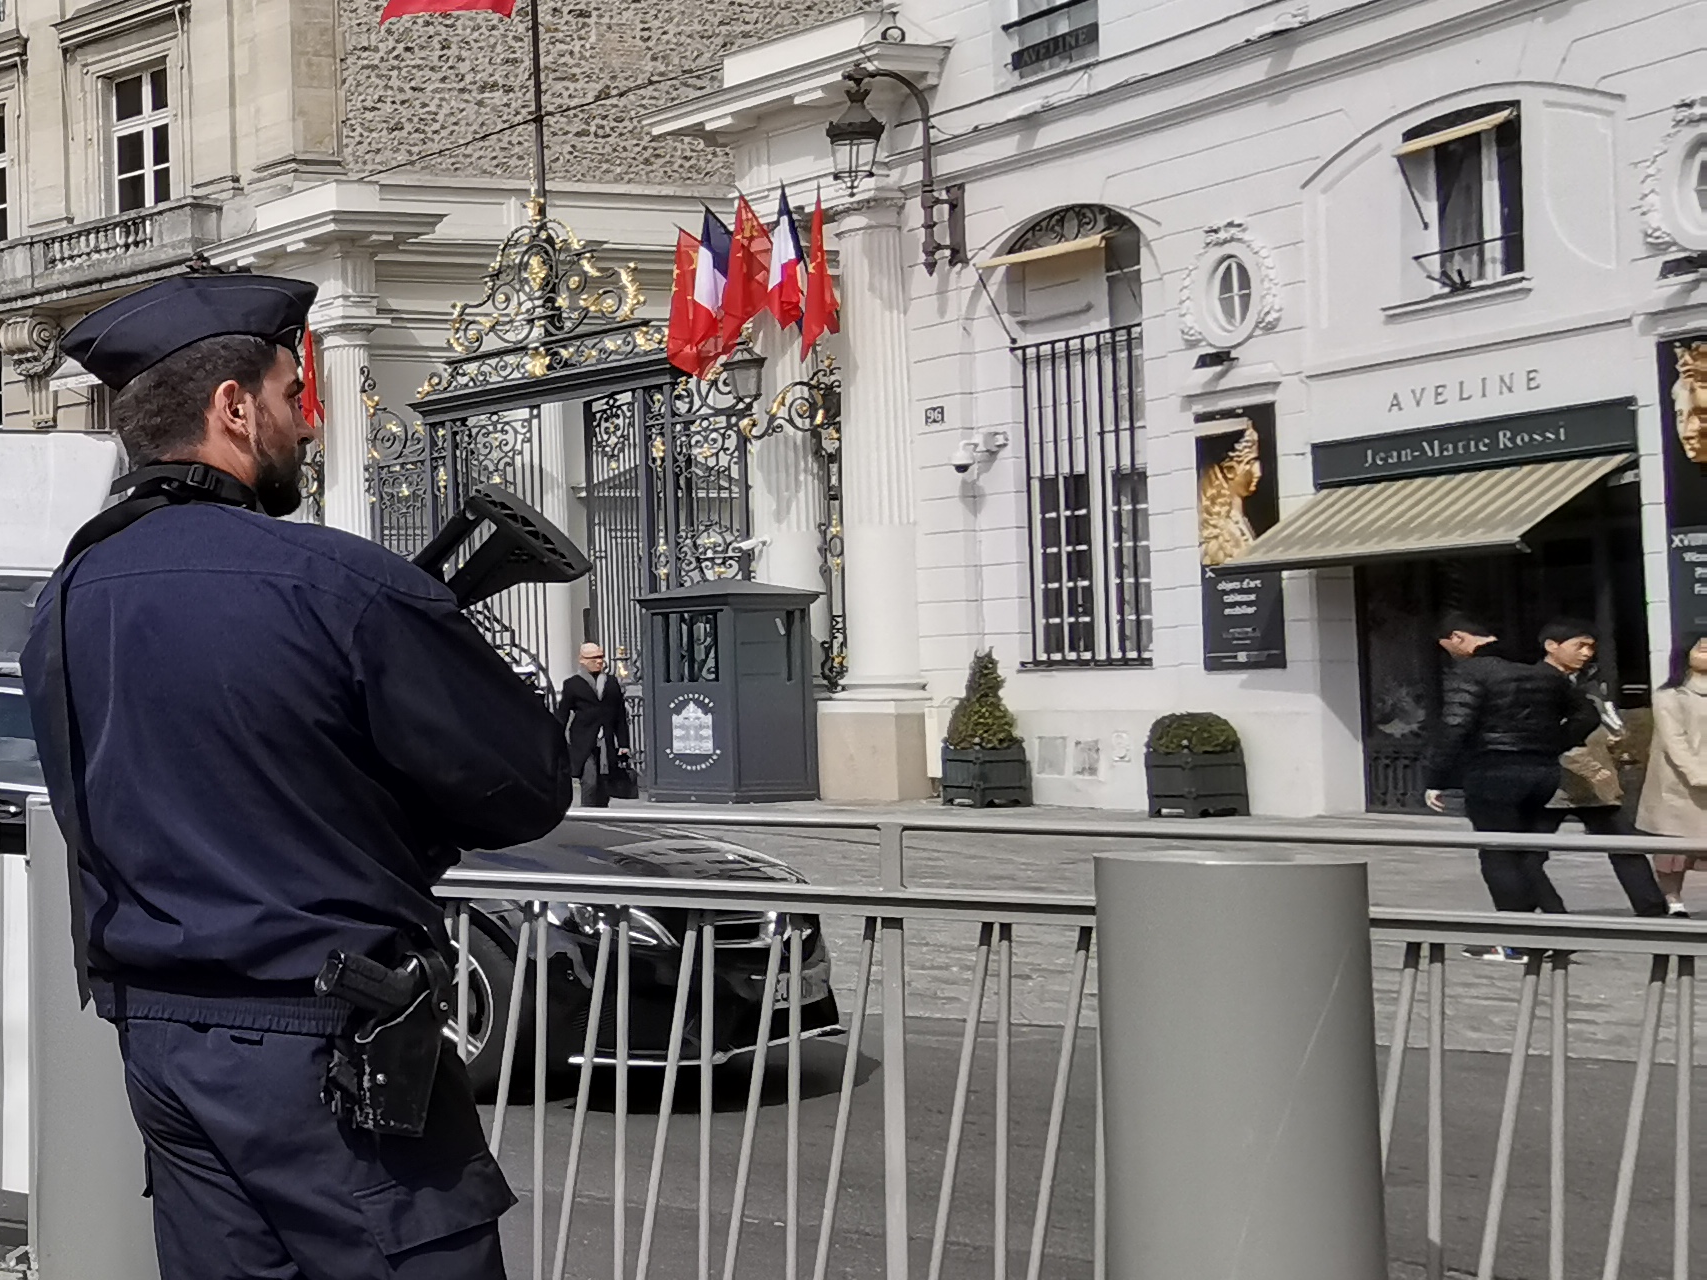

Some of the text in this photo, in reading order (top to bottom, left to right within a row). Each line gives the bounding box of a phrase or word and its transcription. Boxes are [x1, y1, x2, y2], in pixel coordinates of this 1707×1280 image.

[1387, 369, 1541, 413] AVELINE
[926, 407, 942, 423] 96
[1363, 421, 1566, 468] Jean-Marie Rossi
